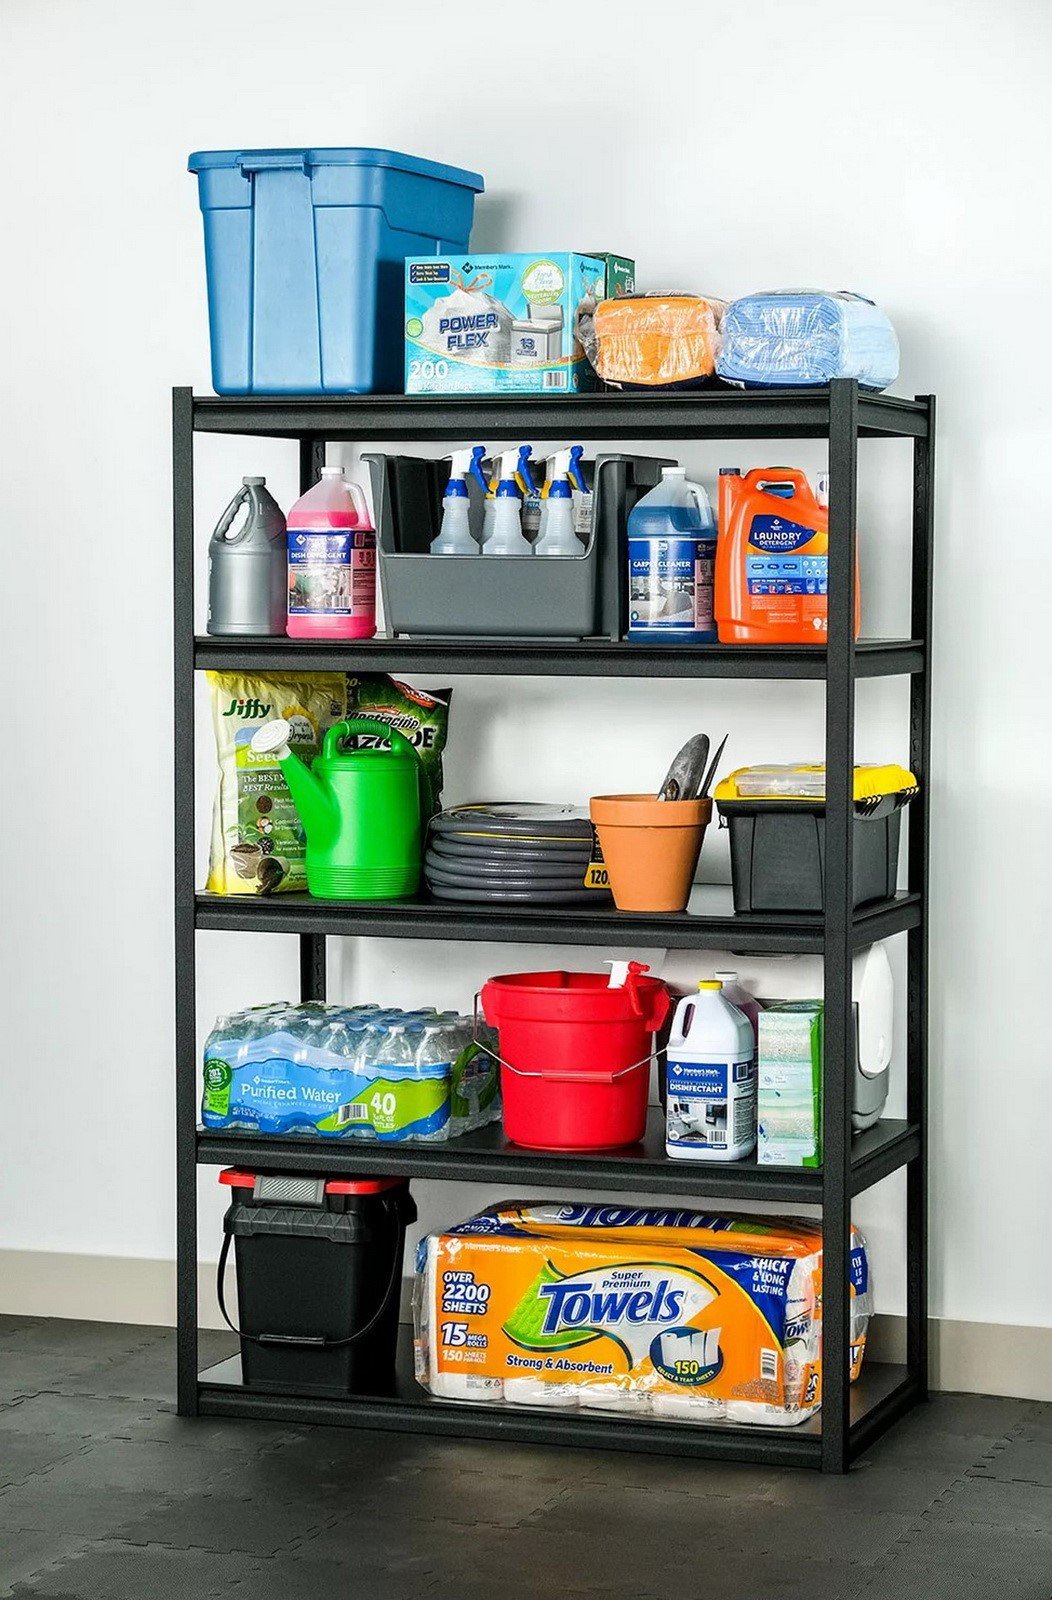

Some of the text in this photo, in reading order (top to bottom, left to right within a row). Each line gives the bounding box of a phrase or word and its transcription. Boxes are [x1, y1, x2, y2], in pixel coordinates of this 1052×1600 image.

[439, 313, 498, 333] POWER
[447, 331, 490, 352] FLEX
[520, 338, 535, 350] 13
[409, 360, 450, 380] 200
[754, 532, 802, 540] LAUNDRY
[222, 699, 271, 719] Jiffy
[242, 773, 279, 783] The BEST
[243, 784, 264, 792] BEST
[241, 1083, 342, 1103] Purified Water
[669, 1084, 723, 1093] DISINFECTANT
[370, 1092, 396, 1115] 40
[751, 1258, 790, 1274] THICK
[443, 1273, 473, 1282] OVER
[611, 1271, 643, 1282] Super
[752, 1271, 785, 1286] & LONG
[602, 1279, 650, 1289] Premium
[752, 1283, 783, 1297] LASTING
[444, 1284, 489, 1302] 2200
[443, 1301, 486, 1314] SHEETS
[540, 1281, 685, 1334] Towels
[442, 1323, 467, 1346] 15
[442, 1350, 463, 1361] 150
[506, 1355, 613, 1374] Strong & Absorbent
[675, 1361, 699, 1375] 150
